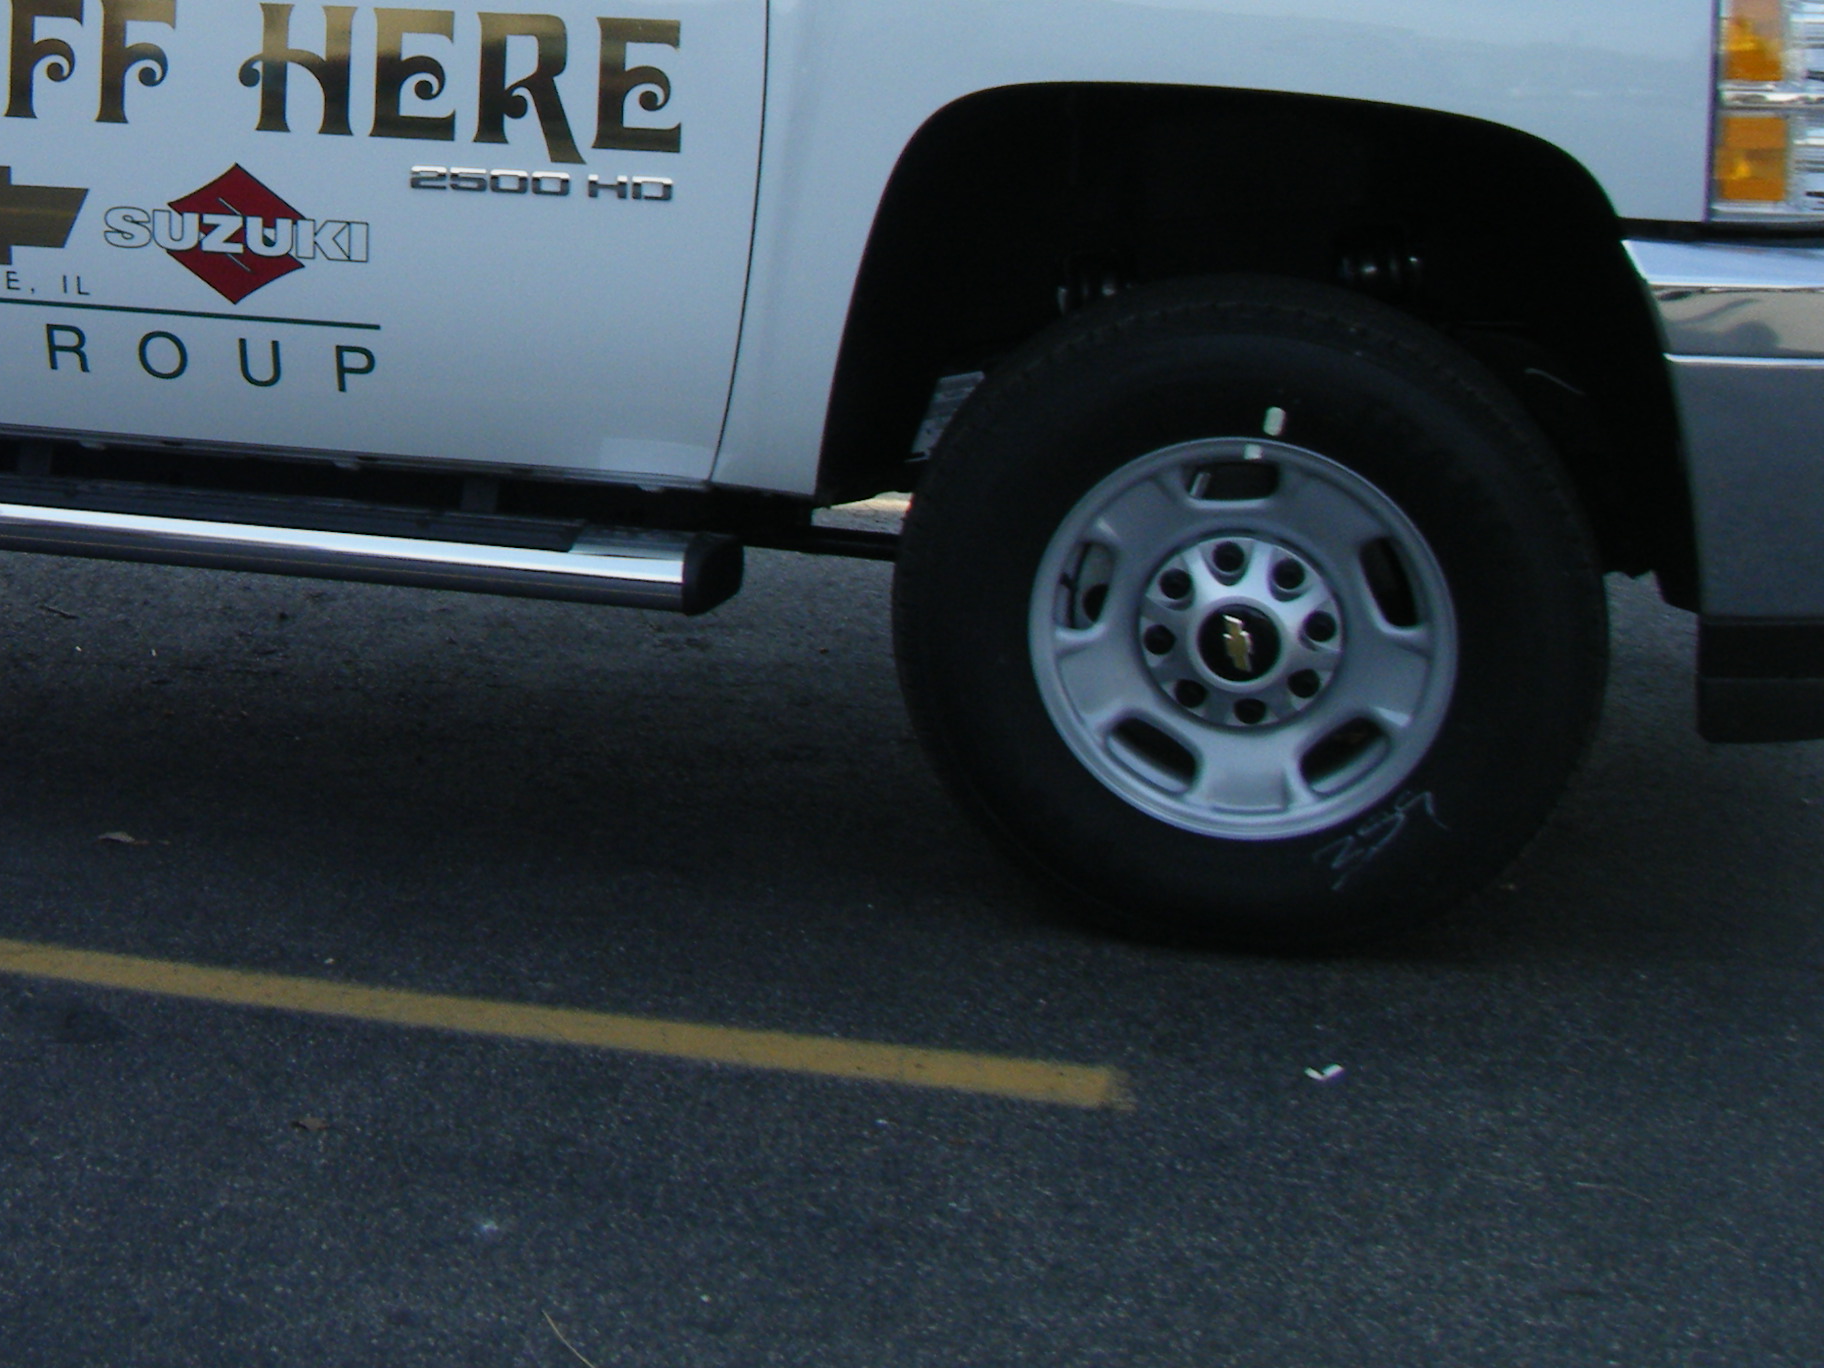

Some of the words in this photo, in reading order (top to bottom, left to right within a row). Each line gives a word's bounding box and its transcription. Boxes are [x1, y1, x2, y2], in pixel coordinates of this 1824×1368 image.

[238, 2, 681, 165] HERE
[409, 165, 571, 197] 2500
[587, 174, 675, 202] HD
[104, 205, 370, 264] SUZUKI
[62, 274, 92, 297] IL
